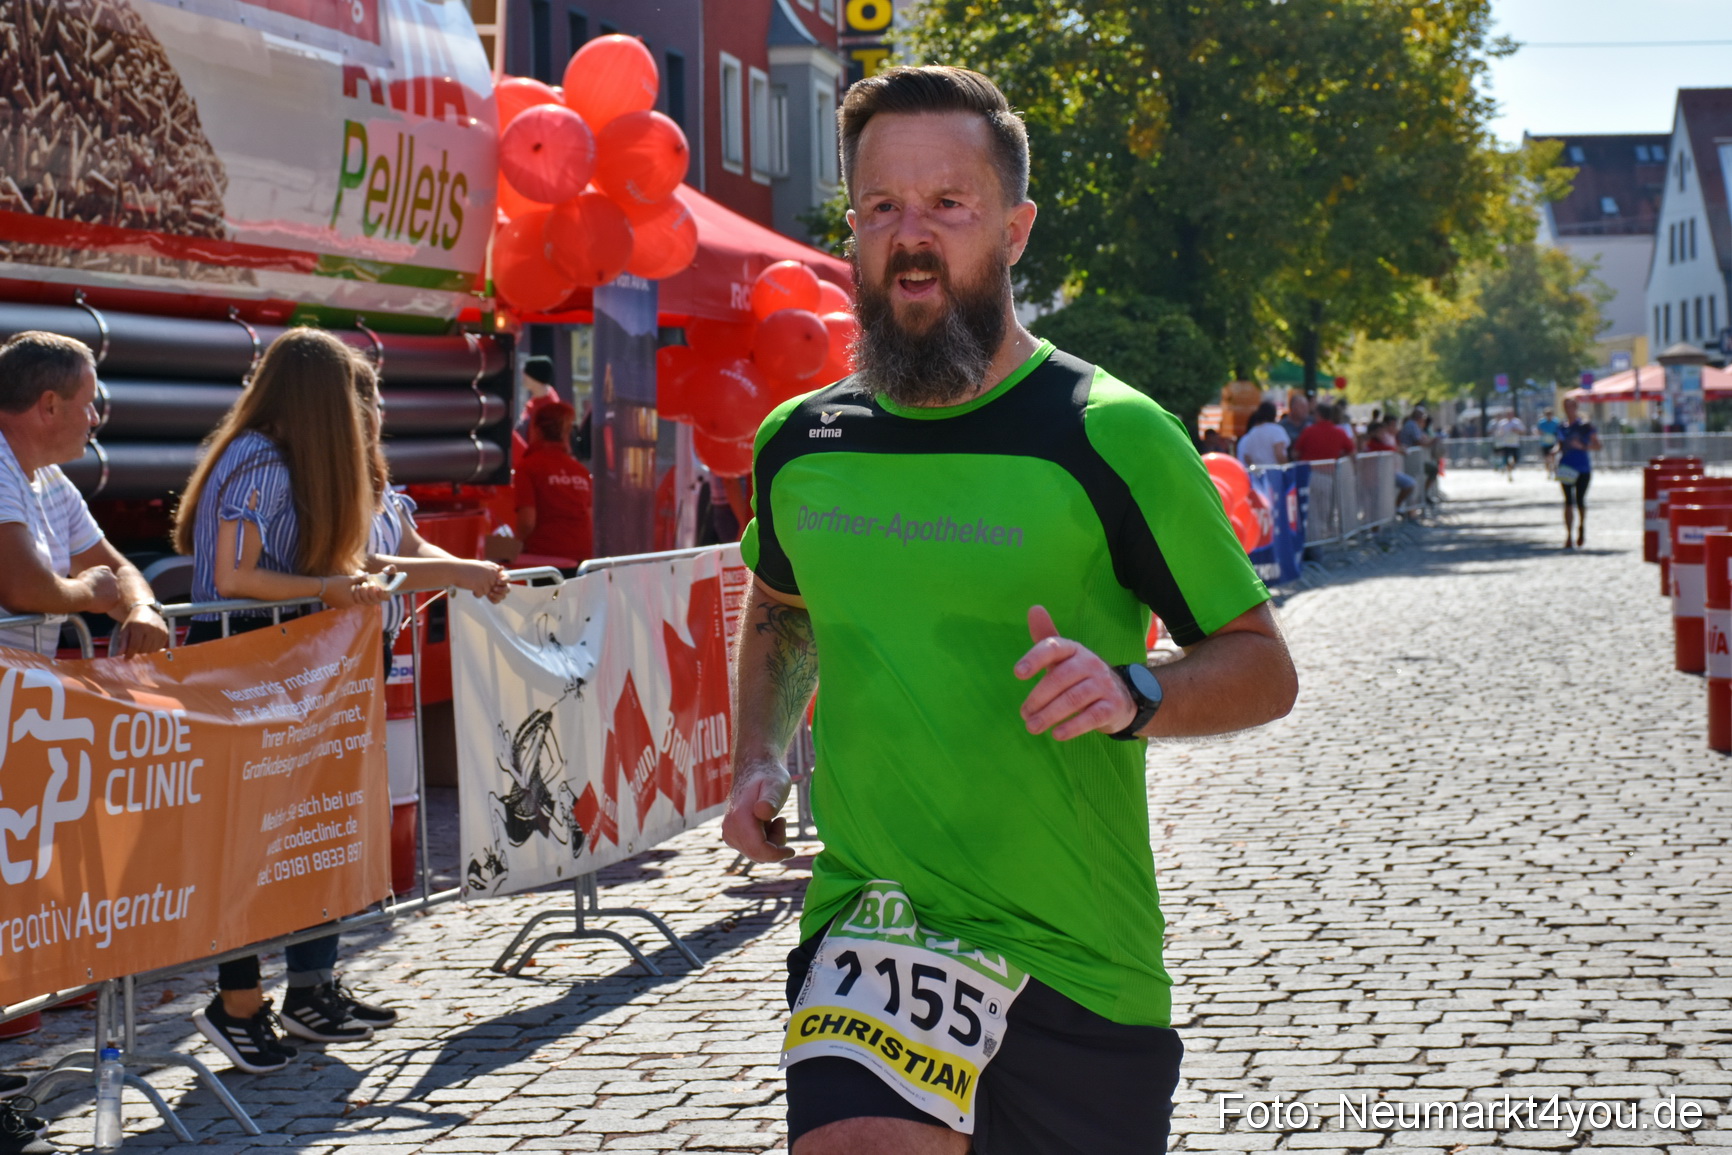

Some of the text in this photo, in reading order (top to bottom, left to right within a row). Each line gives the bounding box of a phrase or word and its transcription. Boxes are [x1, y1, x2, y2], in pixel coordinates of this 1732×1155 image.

[330, 119, 468, 250] Pellets
[808, 426, 842, 438] erima
[797, 505, 1024, 548] Dorfner-Apotheken
[220, 680, 286, 702] Neumarkts
[284, 661, 341, 690] moderner
[108, 708, 191, 761] CODE
[104, 758, 204, 816] CLINIC
[298, 795, 322, 818] sich
[322, 790, 345, 811] bei
[284, 815, 358, 849] codeclinic.de
[274, 855, 311, 881] 09181
[312, 846, 345, 871] 8833
[0, 882, 195, 958] reativAgentur
[834, 950, 985, 1047] 1155
[800, 1013, 972, 1100] CHRISTIAN
